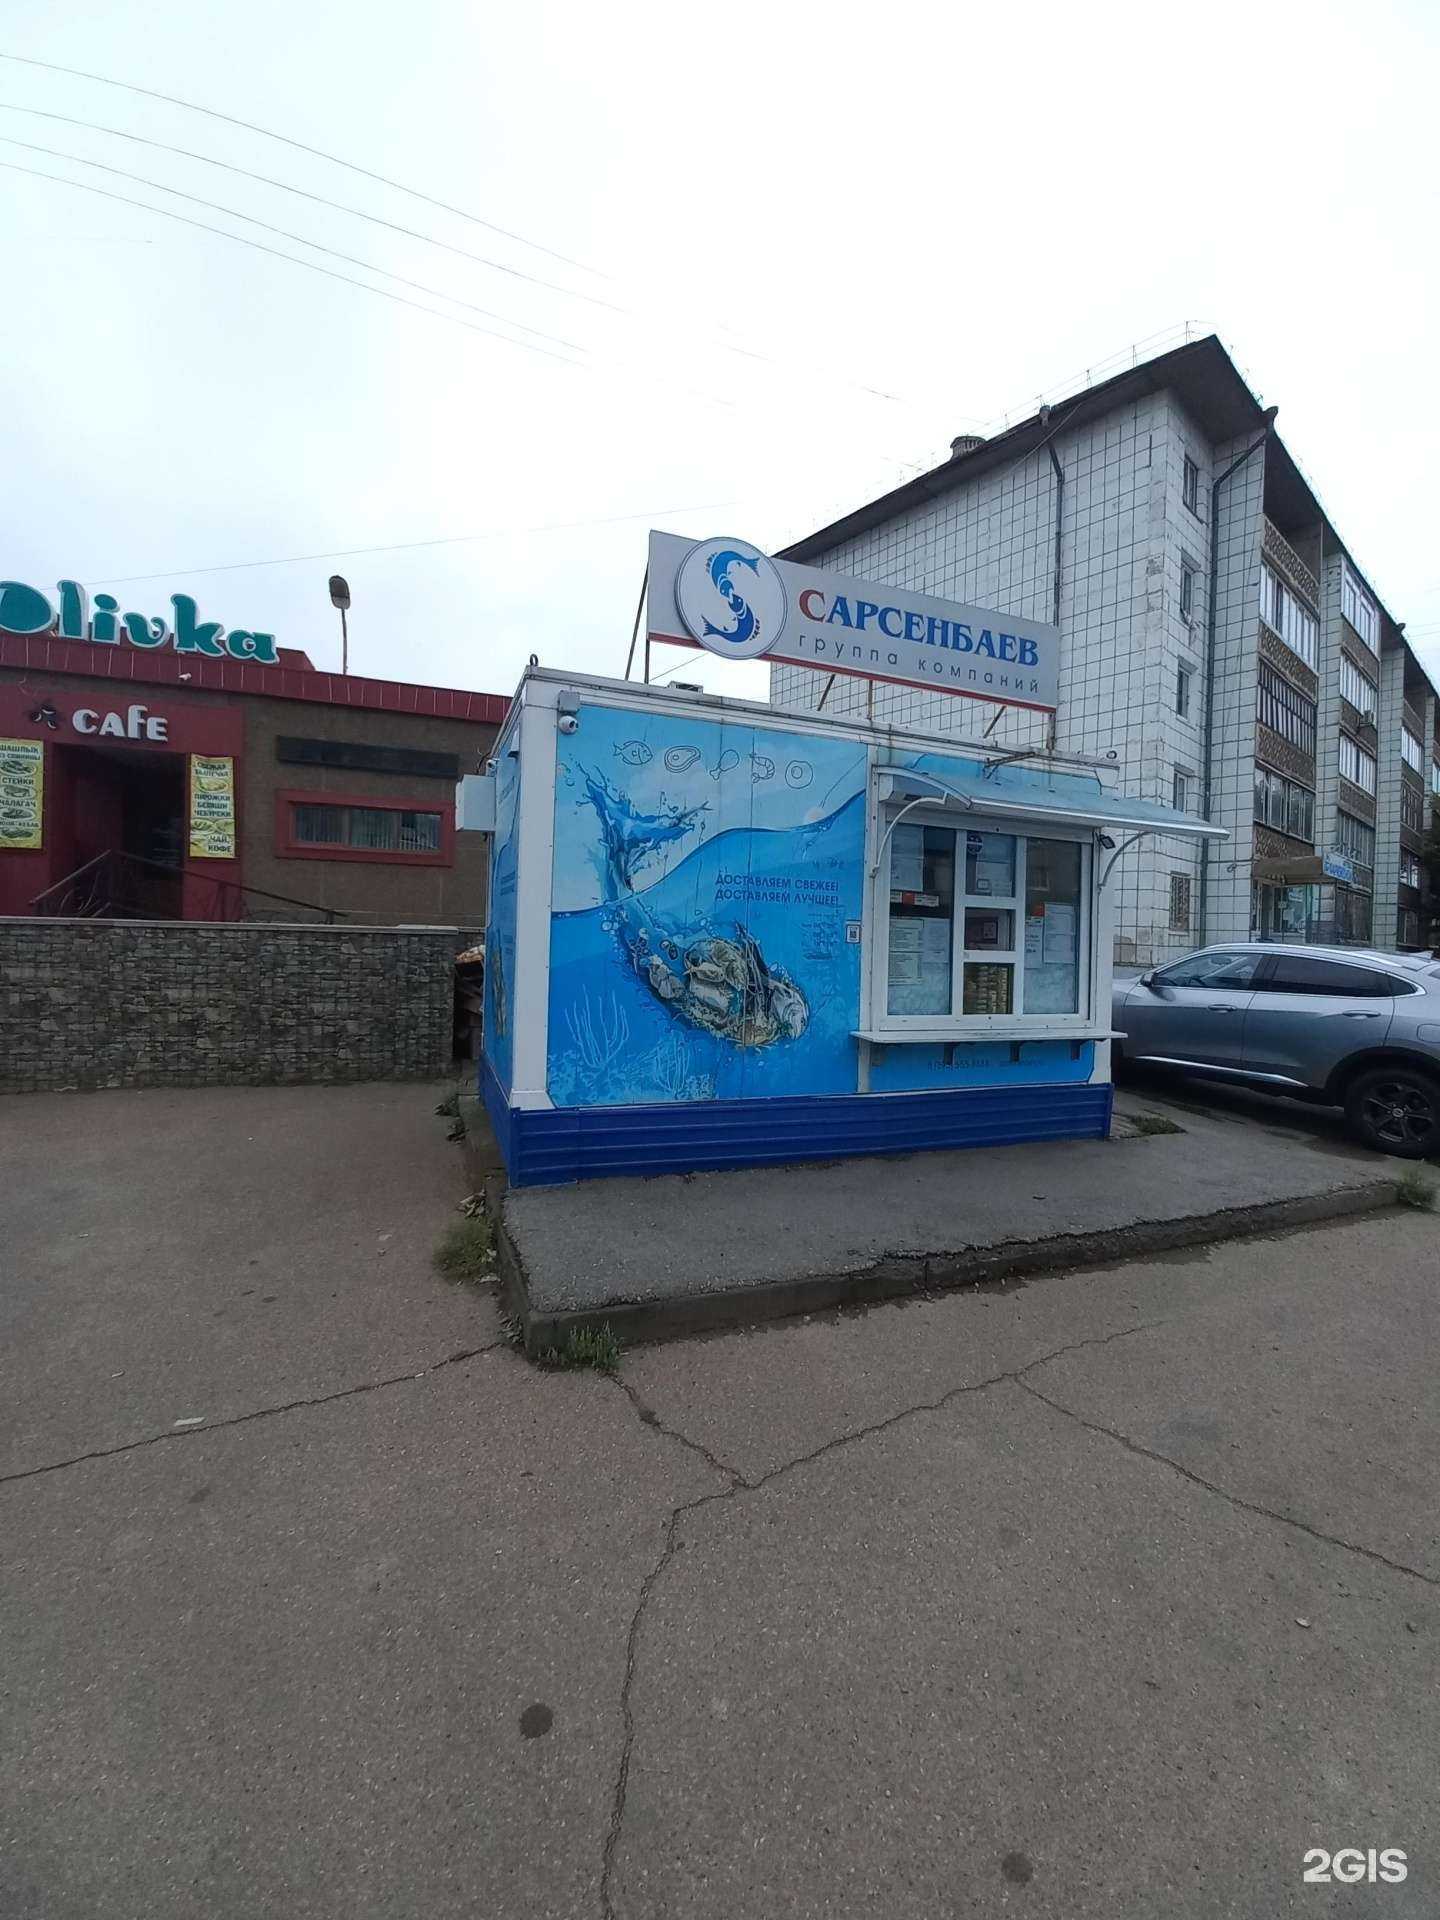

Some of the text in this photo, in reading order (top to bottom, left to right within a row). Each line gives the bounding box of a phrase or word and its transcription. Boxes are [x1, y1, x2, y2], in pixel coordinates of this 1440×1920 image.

[0, 580, 280, 664] Olivka
[799, 588, 1039, 667] САРСЕНБАЕВ
[799, 633, 1039, 693] группа компаний
[72, 704, 169, 742] CAFE
[714, 874, 839, 892] ДОСТАВЛЯЕМ СВЕЖЕЕ!
[714, 888, 839, 905] ДОСТАВЛЯЕМ ЛУЧШЕЕ!
